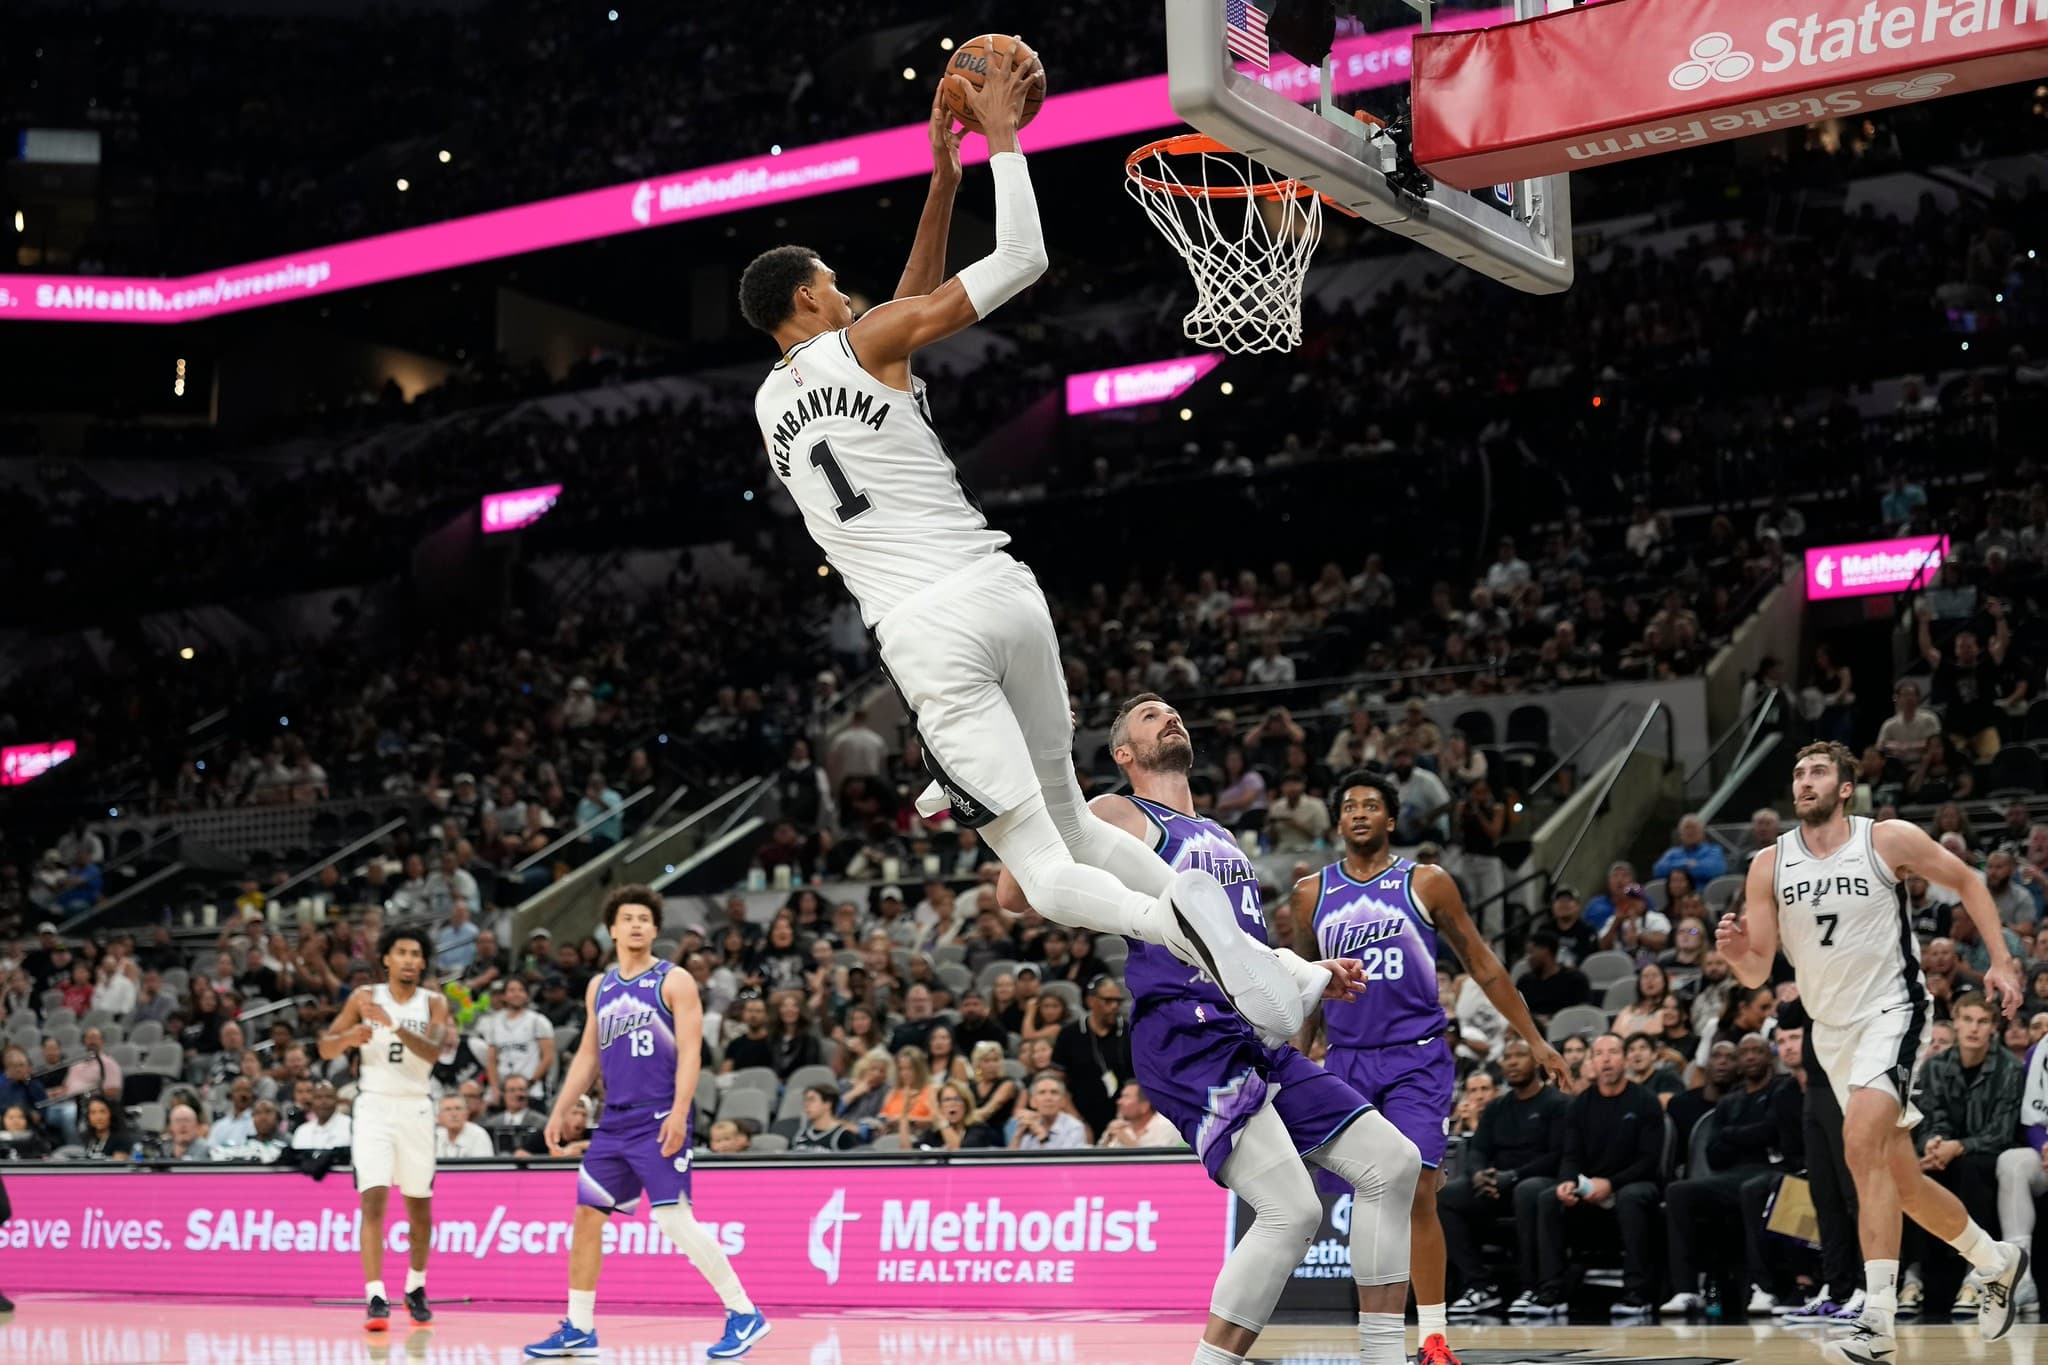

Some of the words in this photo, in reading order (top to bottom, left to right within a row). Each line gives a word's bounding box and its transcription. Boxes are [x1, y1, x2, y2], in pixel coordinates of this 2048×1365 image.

[1347, 45, 1412, 77] scre
[660, 167, 768, 211] Methodist
[769, 157, 859, 189] HEALTHCARE
[36, 262, 330, 311] SAHealth.com/screenings
[773, 387, 891, 477] WEMBANYAMA
[808, 436, 875, 526] 1
[1380, 880, 1402, 889] LVT
[1783, 877, 1869, 907] SPURS
[1241, 885, 1267, 928] 4
[1322, 918, 1407, 960] UTAH
[1816, 914, 1838, 946] 7
[1363, 947, 1404, 980] 28
[600, 1008, 657, 1050] UTAH
[628, 1030, 654, 1057] 13
[388, 1042, 403, 1063] 2
[81, 1208, 172, 1250] lives.
[880, 1197, 1159, 1251] Methodist
[877, 1260, 1075, 1283] HEALTHCARE
